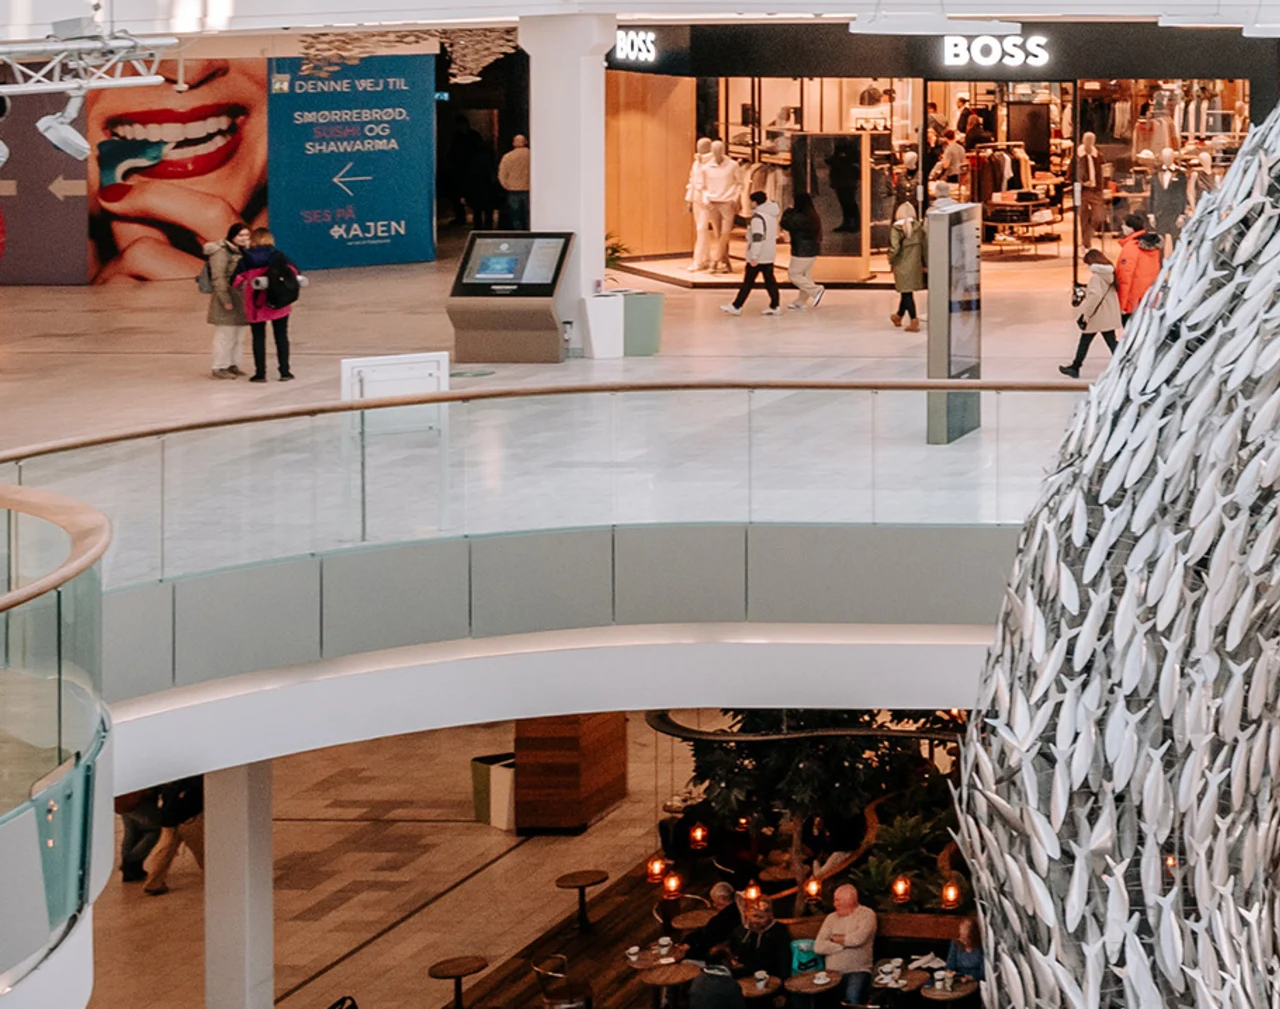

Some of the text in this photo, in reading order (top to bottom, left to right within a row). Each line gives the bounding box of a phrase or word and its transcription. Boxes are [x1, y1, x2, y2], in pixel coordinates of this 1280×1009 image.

[616, 30, 655, 62] BOSS
[944, 34, 1050, 66] BOSS
[295, 77, 409, 93] DENNE VEJ TIL
[313, 123, 390, 139] SUSHI OG
[304, 138, 399, 154] SHAWARMA
[336, 204, 356, 221] PÅ
[329, 220, 406, 239] KAJEN
